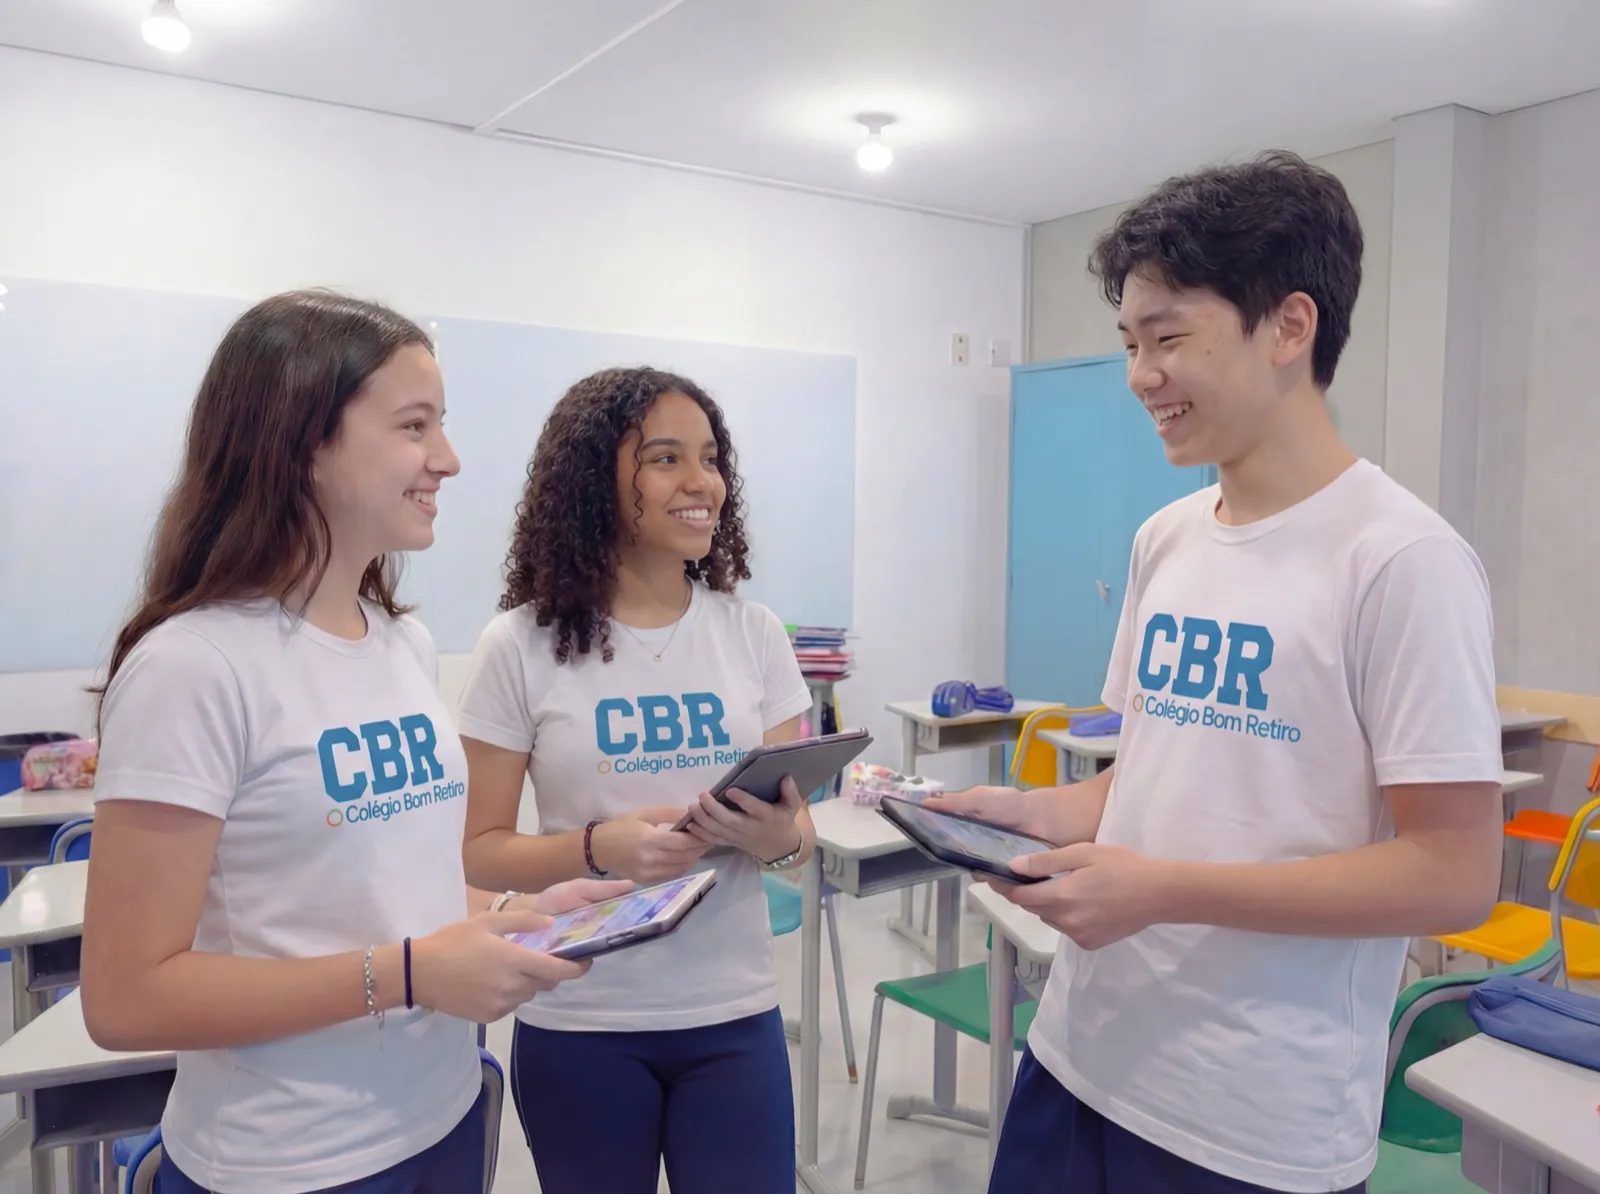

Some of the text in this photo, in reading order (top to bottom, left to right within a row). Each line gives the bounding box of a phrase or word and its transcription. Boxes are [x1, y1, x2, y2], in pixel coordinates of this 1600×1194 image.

[1138, 613, 1275, 711] CBR
[595, 692, 731, 756] CBR
[1145, 696, 1301, 743] Colégio Bom Retiro
[317, 713, 445, 803] CBR
[614, 747, 750, 774] Colégio Bom Retir
[346, 780, 466, 824] Colégio Bom Retiro
